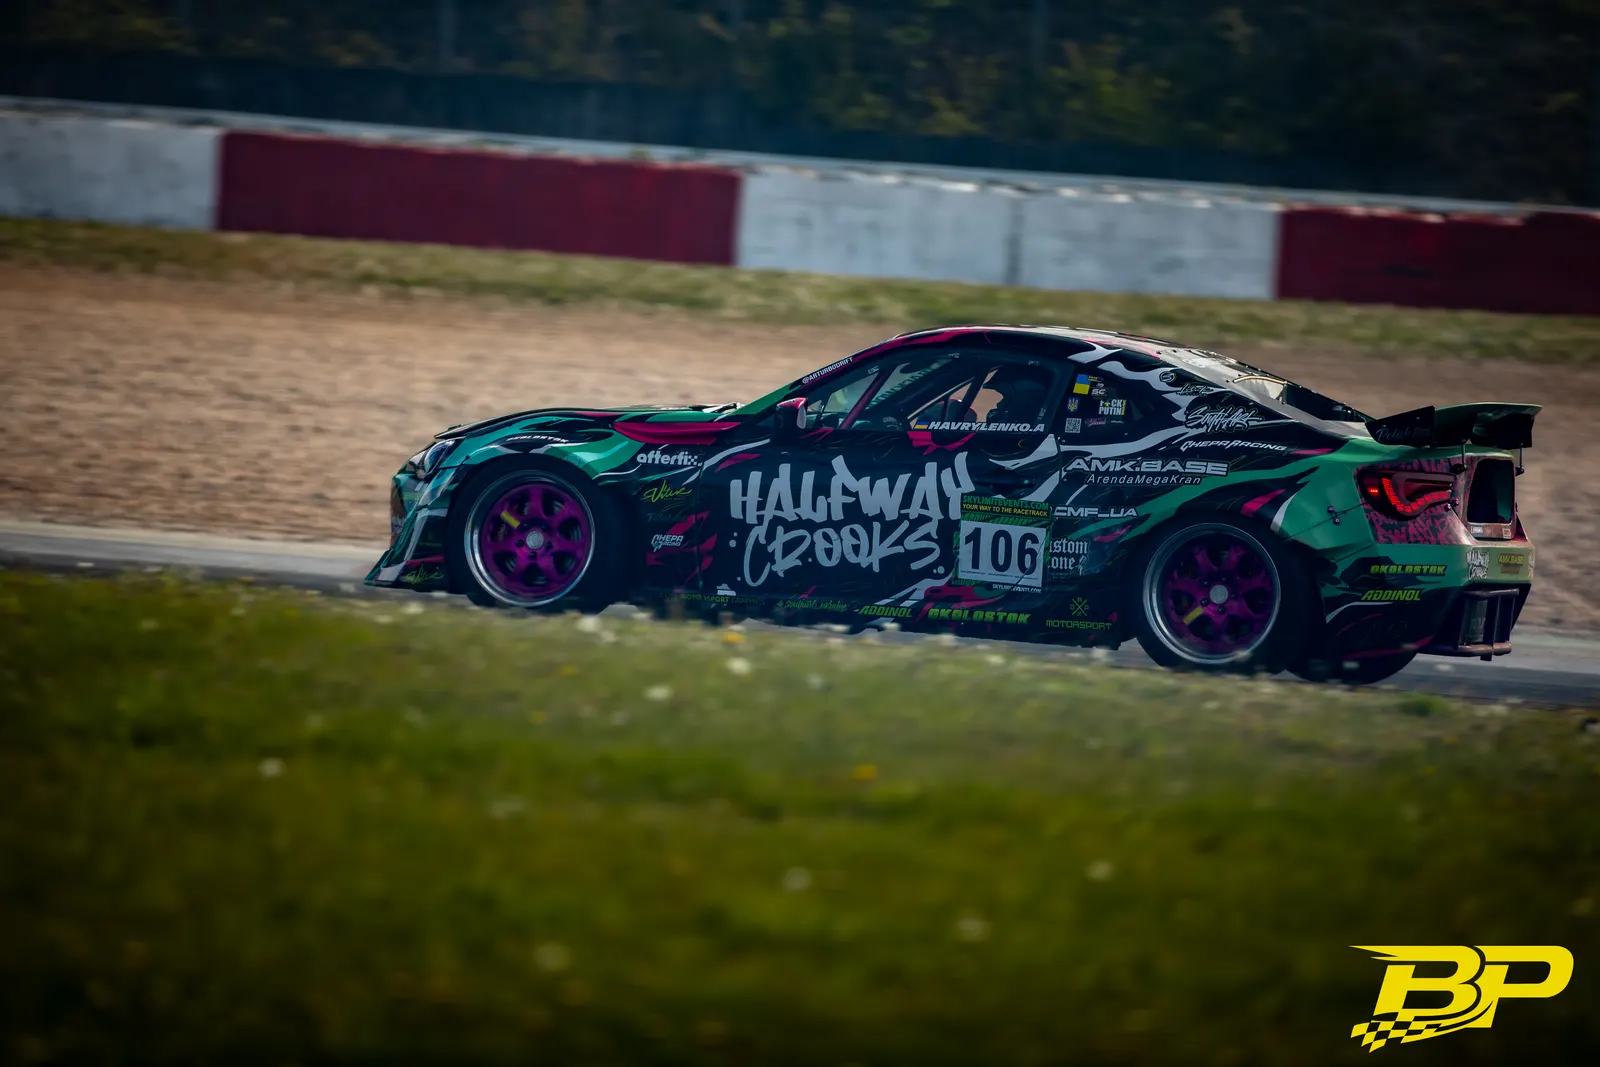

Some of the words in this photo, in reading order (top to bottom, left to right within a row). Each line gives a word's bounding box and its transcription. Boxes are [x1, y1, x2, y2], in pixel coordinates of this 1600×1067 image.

[801, 356, 853, 384] @ARTURBODRIFT
[928, 421, 1046, 433] HAVRYLENKO.A
[1065, 458, 1229, 476] AMK.BASE
[1086, 473, 1202, 486] ArendaMegaKran
[729, 450, 976, 526] HALFWAY
[962, 495, 1050, 510] SKYLIMITEVENTS.COM
[962, 503, 979, 511] YOUR
[1013, 508, 1049, 517] RACETRACK
[1053, 506, 1138, 518] CMF_UA
[743, 519, 941, 587] CROOKS
[964, 526, 1040, 576] 106
[1048, 556, 1076, 571] one
[1361, 589, 1422, 601] ADDINOL
[859, 604, 913, 618] ADDINOL
[1045, 618, 1113, 631] MOTORSPORT
